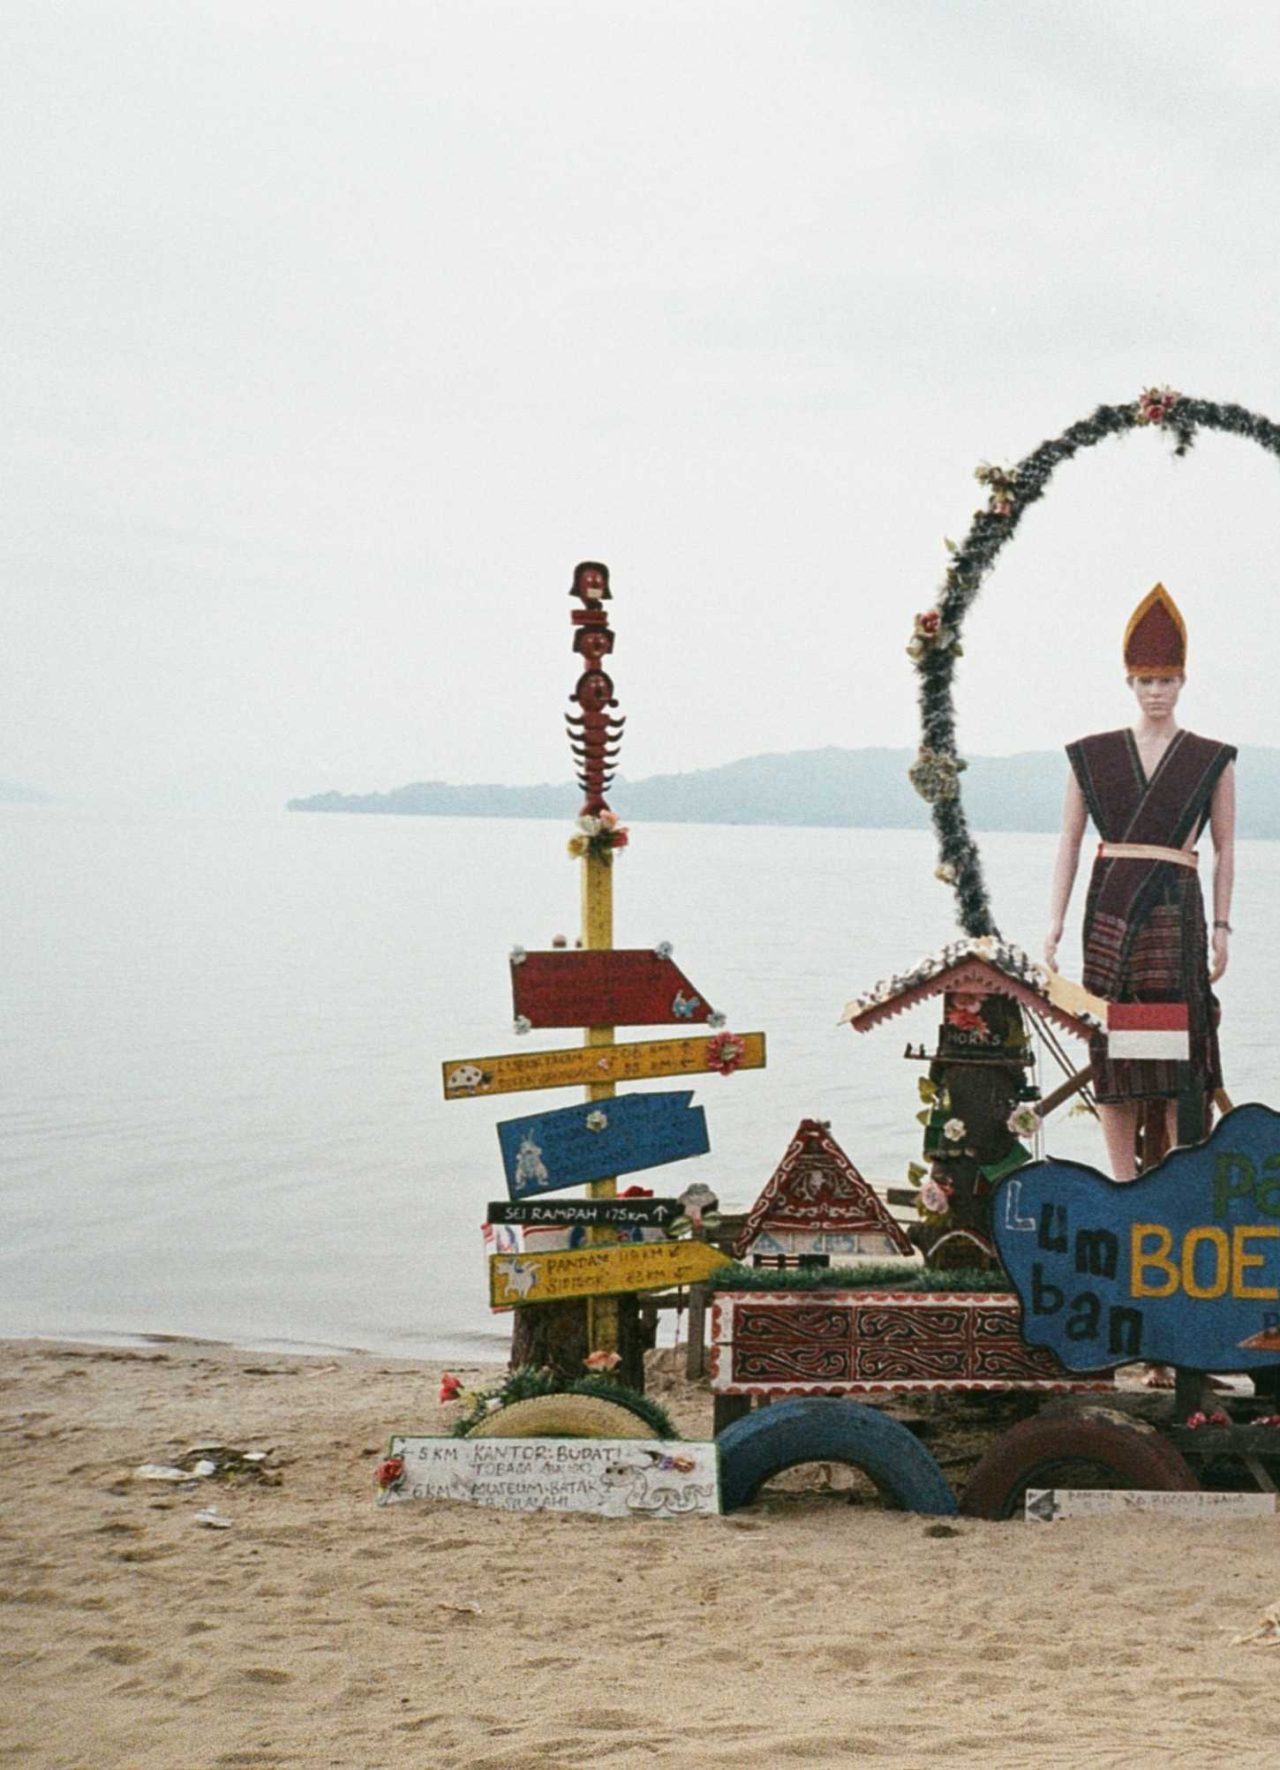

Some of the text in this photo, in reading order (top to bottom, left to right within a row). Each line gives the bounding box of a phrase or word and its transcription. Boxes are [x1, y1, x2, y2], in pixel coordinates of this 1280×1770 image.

[504, 1206, 527, 1221] SEI
[531, 1206, 599, 1220] RAMPAH
[418, 1446, 428, 1461] 5
